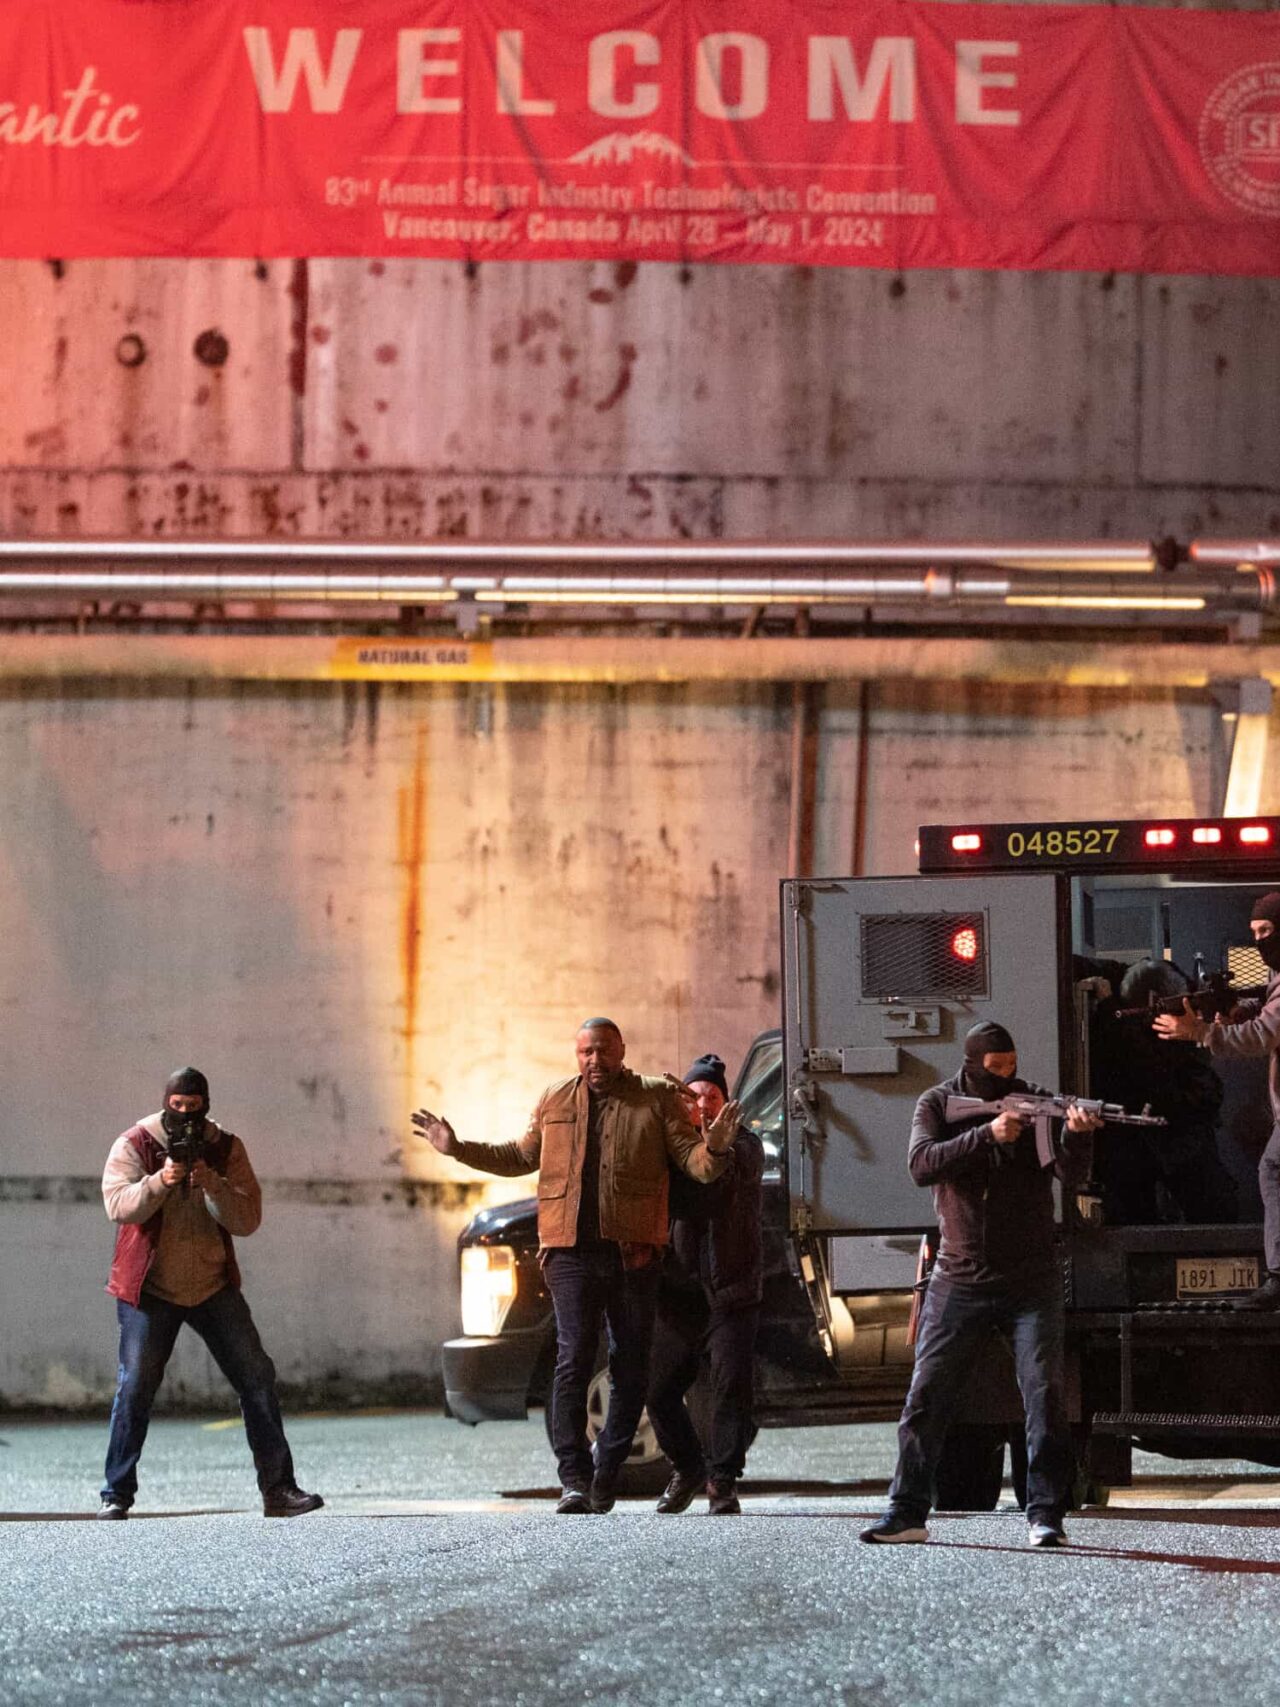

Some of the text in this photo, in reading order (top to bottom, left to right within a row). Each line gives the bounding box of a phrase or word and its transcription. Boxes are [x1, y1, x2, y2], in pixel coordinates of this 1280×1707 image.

[243, 26, 1021, 126] WELCOME
[377, 178, 458, 206] Annual
[463, 176, 531, 210] Sugar
[537, 178, 635, 212] Industry
[806, 184, 938, 215] Convention
[526, 212, 621, 242] Canada
[625, 214, 682, 246] April
[747, 217, 793, 247] May
[824, 218, 885, 247] 2024
[358, 649, 468, 664] NATURAL GAS
[1007, 829, 1120, 857] 048527
[1180, 1269, 1217, 1288] 1891
